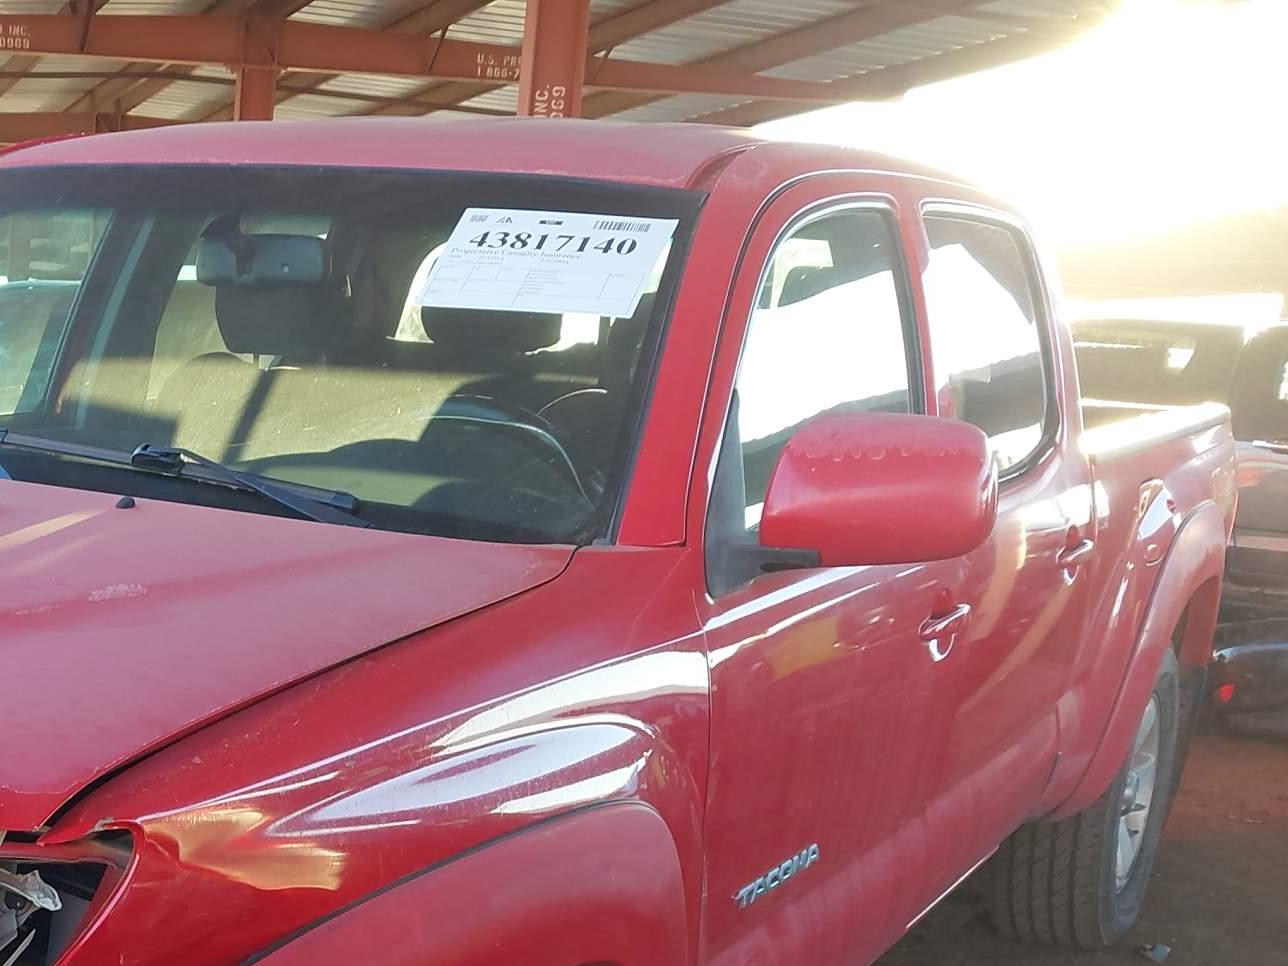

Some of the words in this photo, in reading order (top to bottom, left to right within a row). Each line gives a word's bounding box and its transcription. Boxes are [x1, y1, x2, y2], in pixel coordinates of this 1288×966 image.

[476, 53, 498, 65] U.S.
[469, 231, 637, 255] 43817140
[731, 843, 819, 909] TACOMA
